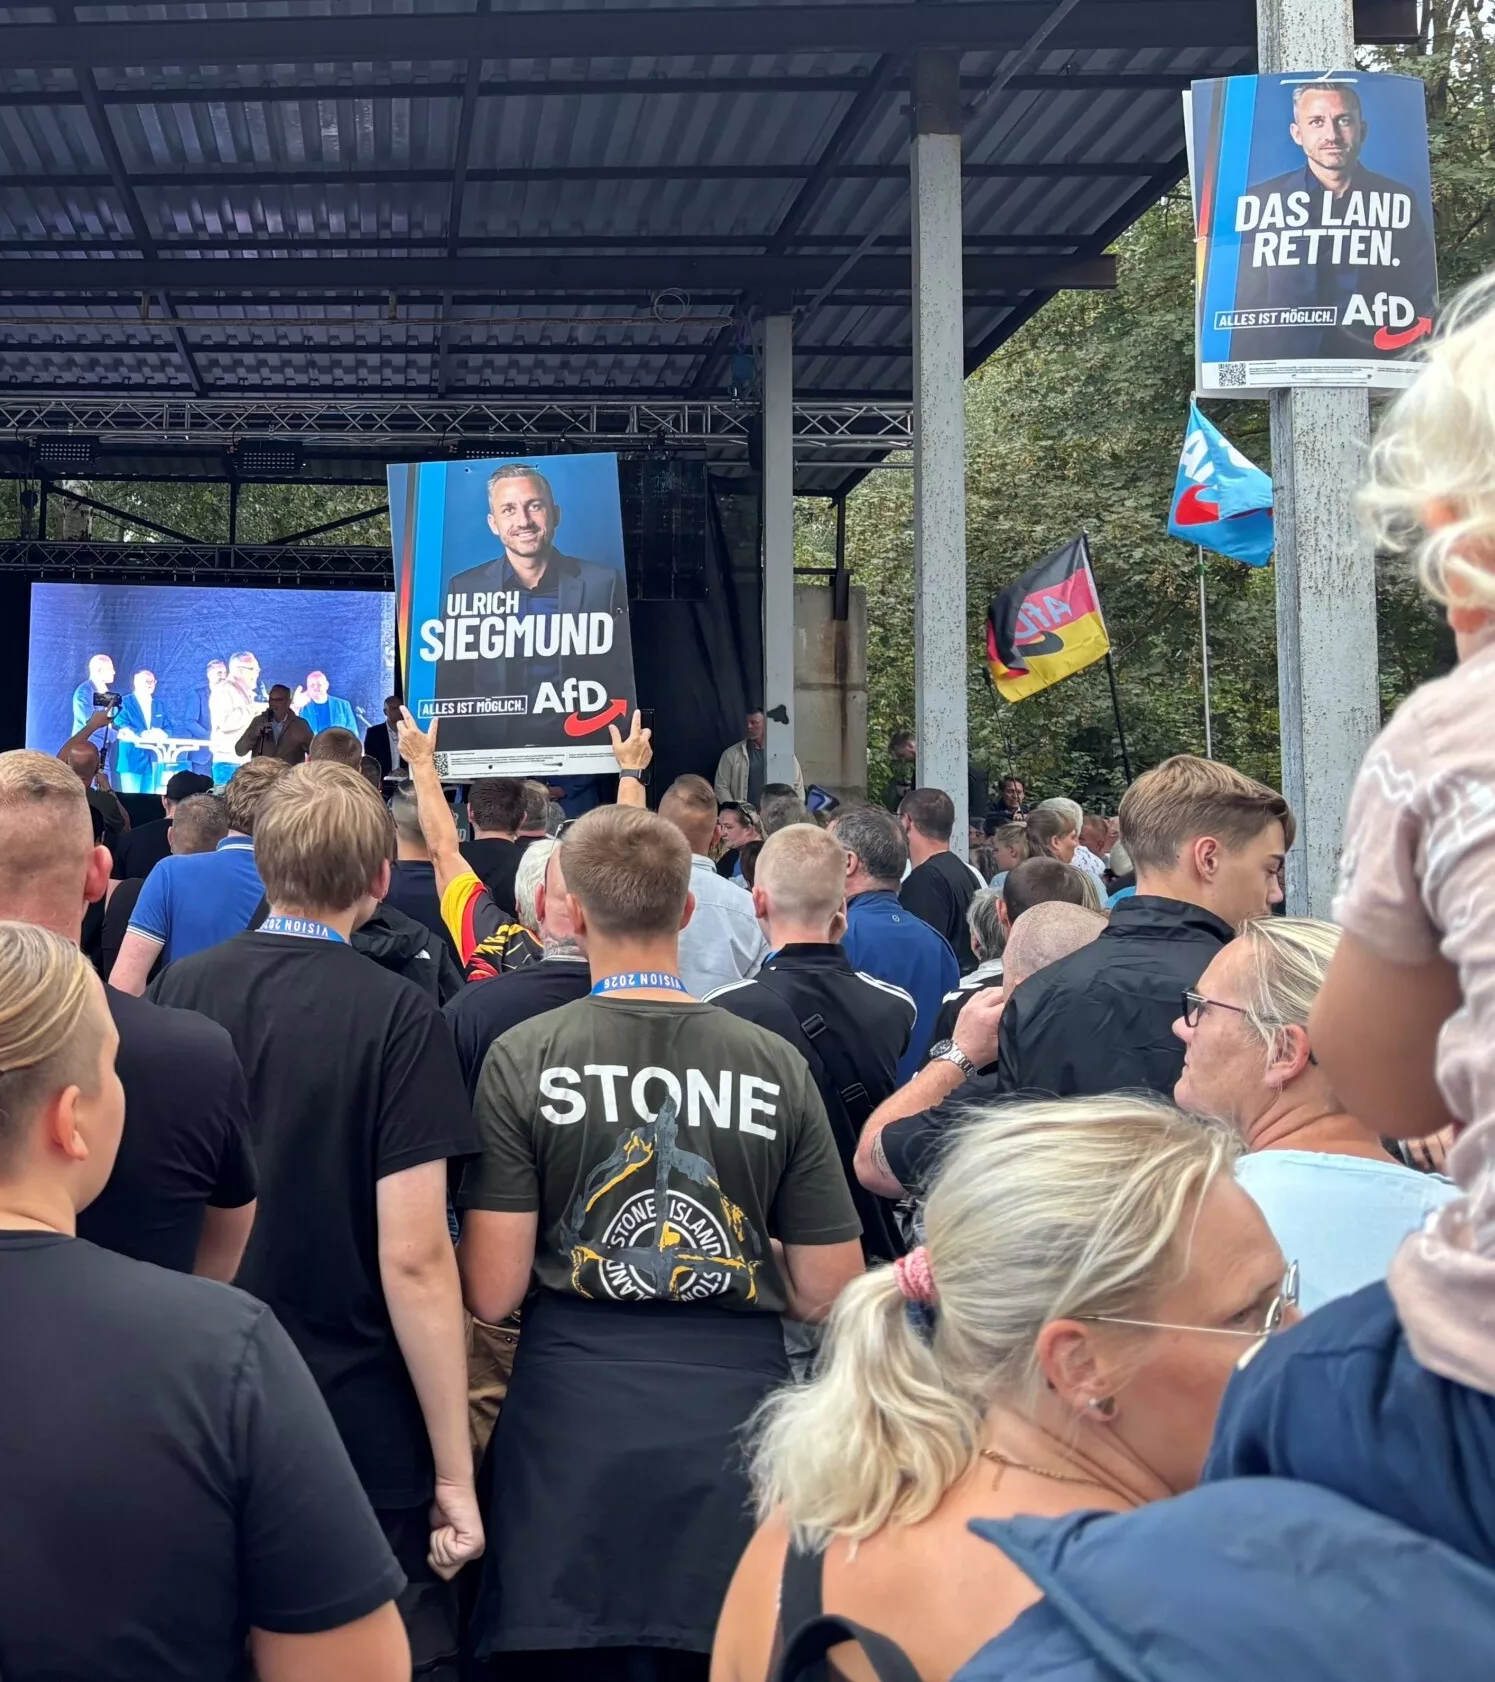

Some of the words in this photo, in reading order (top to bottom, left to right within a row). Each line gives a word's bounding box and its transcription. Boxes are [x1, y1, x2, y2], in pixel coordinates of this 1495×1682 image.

[1234, 190, 1311, 232] DAS
[1321, 190, 1411, 229] LAND
[1252, 228, 1401, 268] RETTEN.
[1218, 314, 1256, 327] ALLES
[1258, 312, 1278, 325] IST
[1279, 308, 1334, 324] MÖGLICH.
[1341, 292, 1415, 327] AfD
[446, 590, 520, 616] ULRICH
[419, 612, 614, 662] SIEGMUND
[422, 701, 455, 716] ALLES
[456, 700, 474, 714] IST
[475, 697, 525, 712] MÖGLICH.
[532, 677, 608, 714] AfD
[285, 919, 329, 937] VISION
[604, 973, 636, 989] 2026
[640, 973, 681, 989] VISION
[539, 1064, 781, 1141] STONE
[610, 1198, 657, 1248] STONE
[669, 1199, 722, 1256] ISLAND
